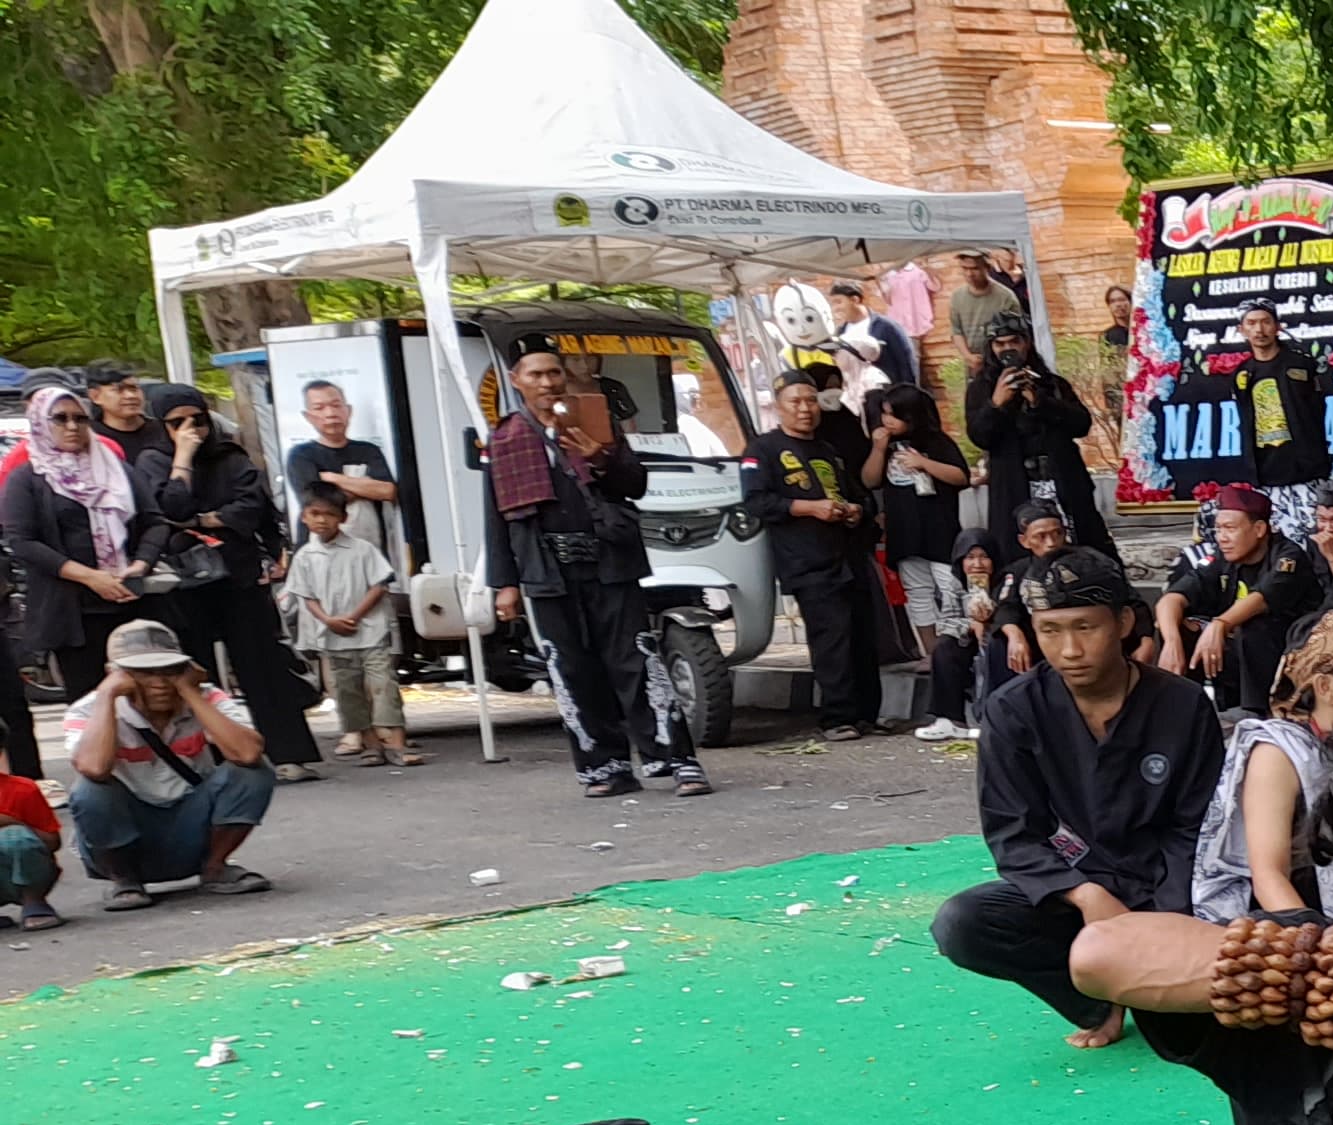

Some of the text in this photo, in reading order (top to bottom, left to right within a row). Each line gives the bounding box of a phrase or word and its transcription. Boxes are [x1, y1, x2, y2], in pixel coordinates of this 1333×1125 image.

[664, 198, 683, 211] PT
[690, 199, 751, 212] DHARMA
[756, 201, 847, 215] ELECTRINDO
